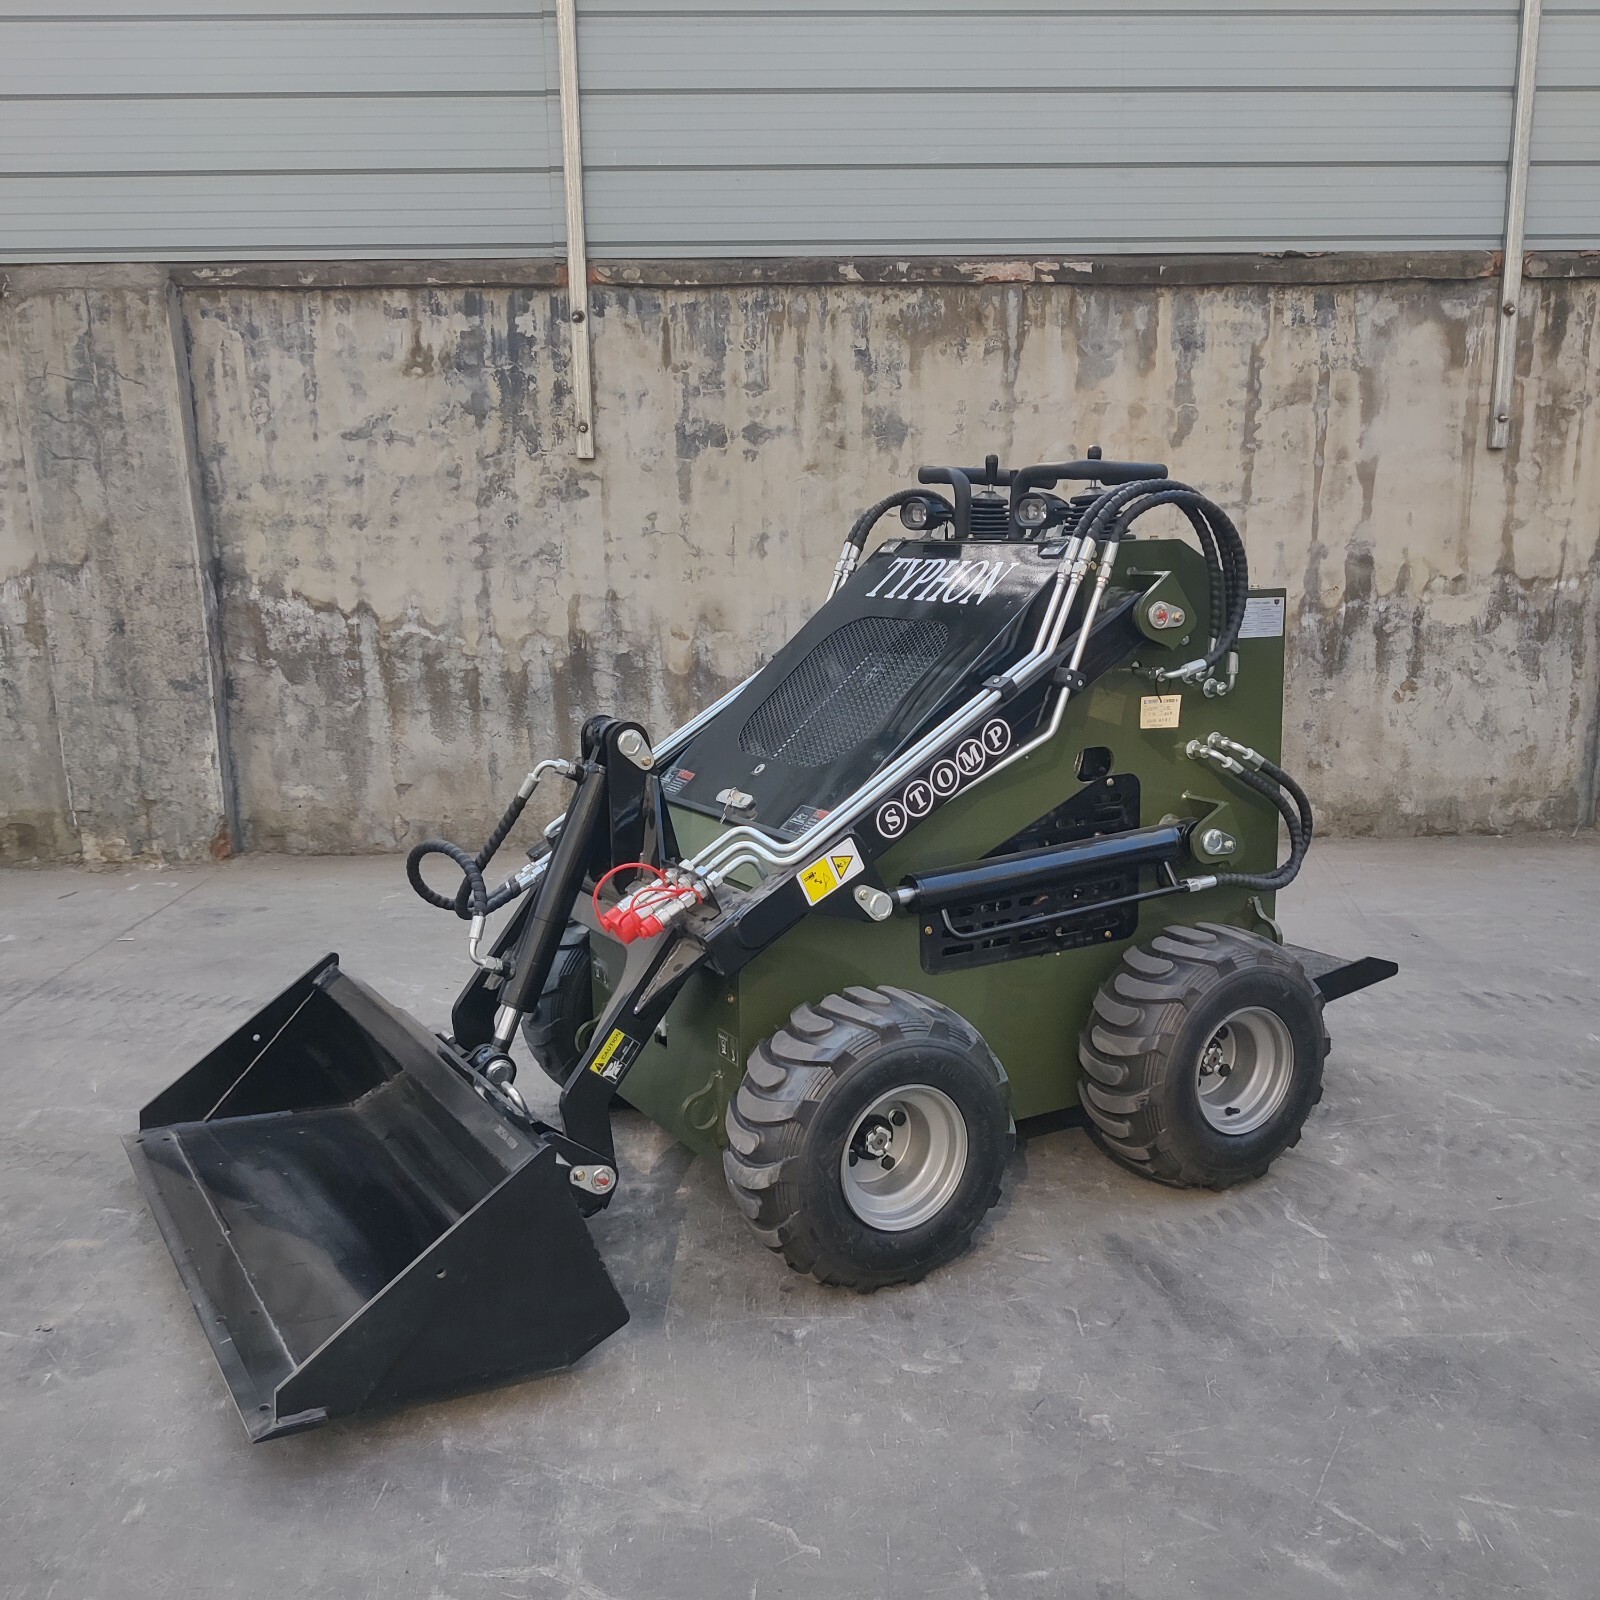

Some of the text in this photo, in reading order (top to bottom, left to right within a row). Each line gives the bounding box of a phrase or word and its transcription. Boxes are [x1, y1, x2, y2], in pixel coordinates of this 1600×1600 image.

[865, 557, 1020, 605] TYPHON
[883, 724, 1004, 833] STOMP
[601, 1032, 621, 1060] CAUTION
